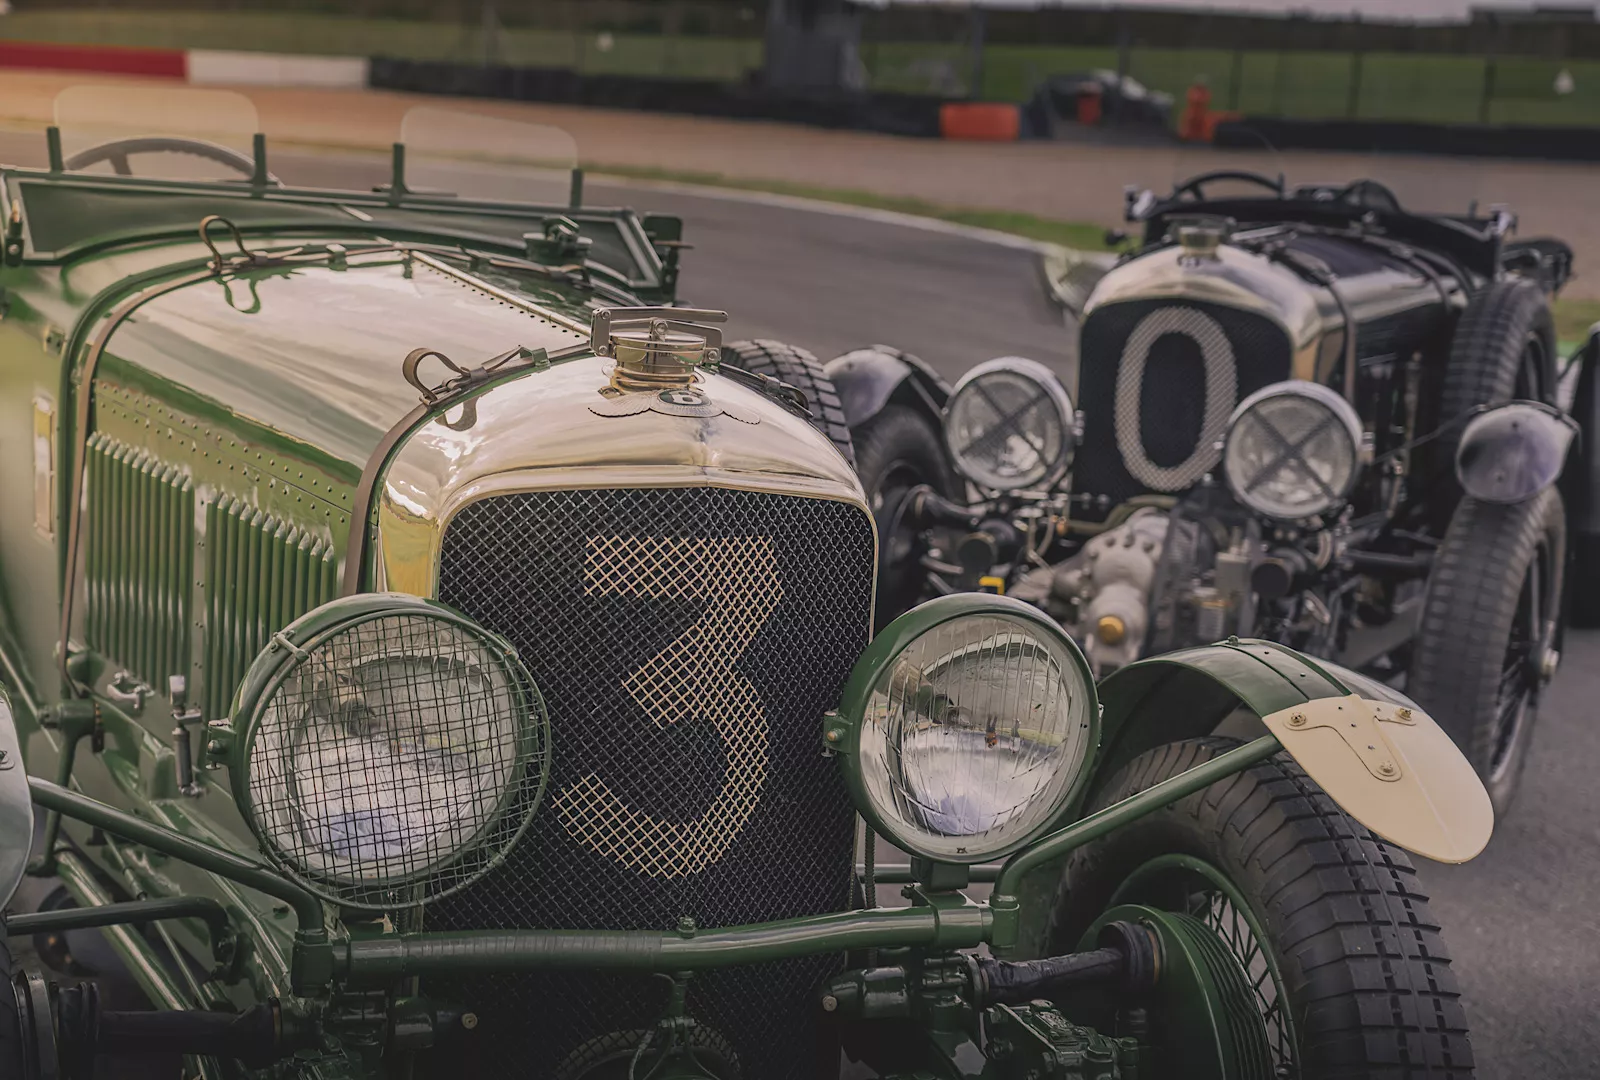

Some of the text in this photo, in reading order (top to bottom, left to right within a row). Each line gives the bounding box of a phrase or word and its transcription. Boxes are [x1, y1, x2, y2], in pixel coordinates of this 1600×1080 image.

[669, 391, 702, 405] B
[1114, 306, 1238, 491] 0
[551, 536, 784, 879] 3
